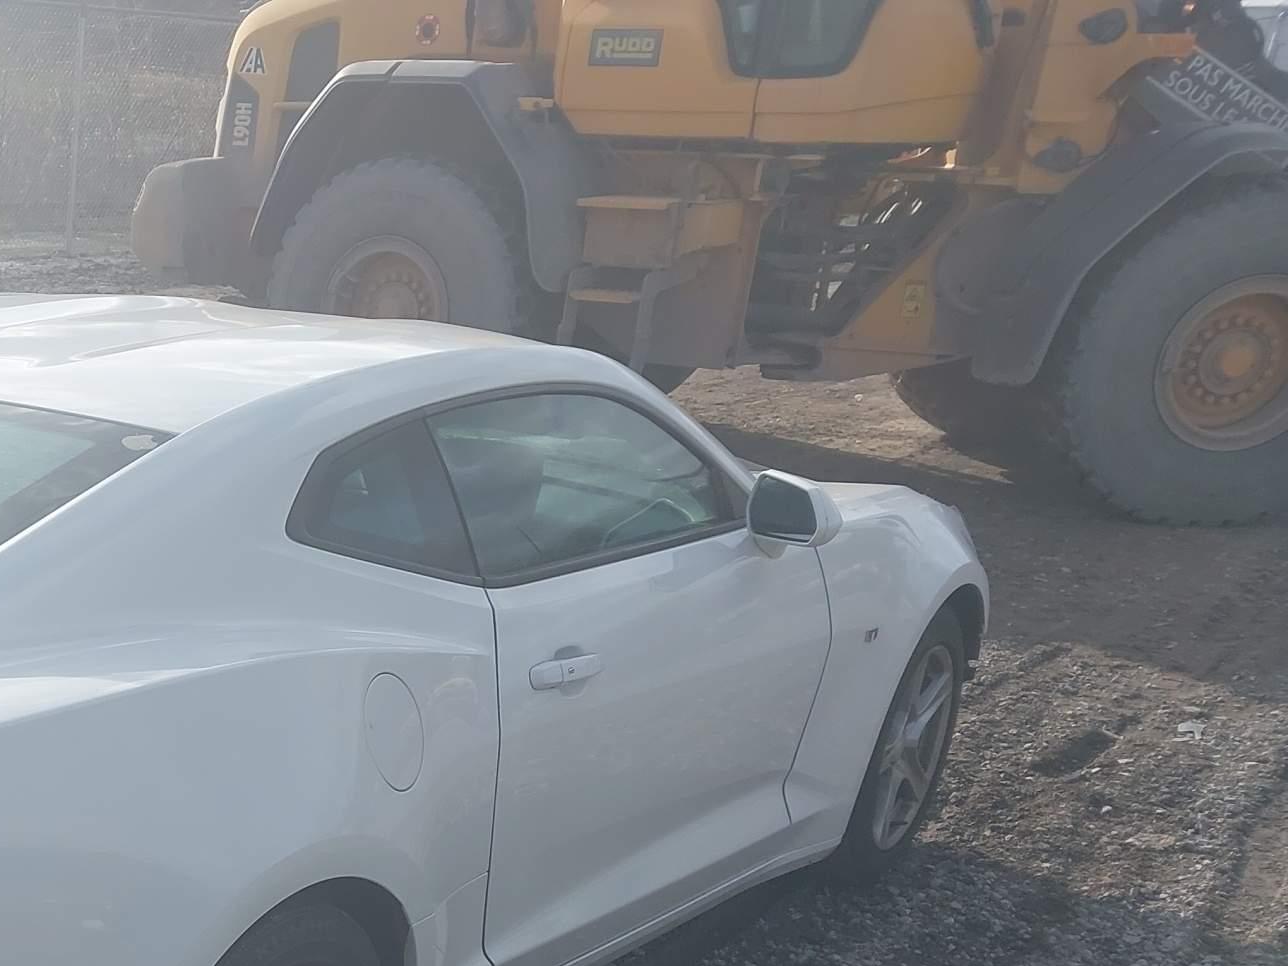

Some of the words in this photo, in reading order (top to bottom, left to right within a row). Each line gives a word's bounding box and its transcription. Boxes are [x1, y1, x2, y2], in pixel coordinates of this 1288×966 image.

[1165, 70, 1216, 111] SOUS
[1186, 55, 1225, 87] PAS
[1220, 77, 1288, 132] MARCH
[231, 102, 253, 147] L90H
